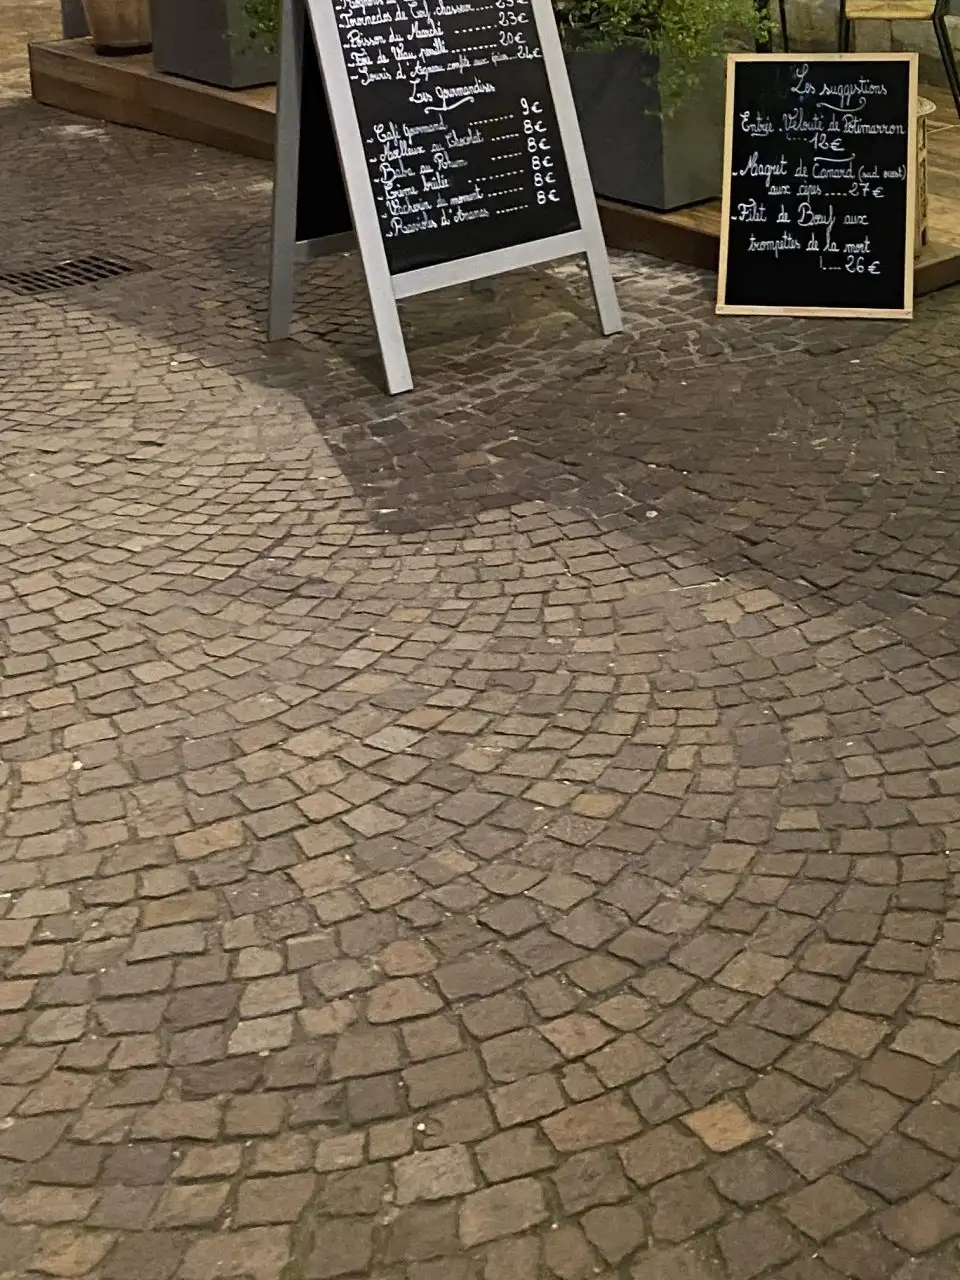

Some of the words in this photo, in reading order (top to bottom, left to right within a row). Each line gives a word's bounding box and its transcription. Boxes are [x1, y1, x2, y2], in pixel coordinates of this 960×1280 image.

[347, 29, 386, 48] Poisson
[389, 27, 404, 42] du
[377, 48, 389, 64] de
[358, 66, 391, 85] Souris
[791, 63, 816, 94] Les
[819, 76, 888, 107] suggestions
[520, 98, 543, 115] 9€
[523, 120, 547, 135] 8€
[783, 107, 825, 131] Velouté
[827, 113, 840, 131] de
[842, 114, 905, 134] Potimarron
[527, 137, 551, 153] 8€
[809, 133, 844, 151] 12€
[531, 156, 554, 170] 8€
[794, 158, 808, 178] de
[812, 160, 855, 178] Canard
[534, 172, 556, 187] 8€
[537, 190, 560, 205] 8€
[737, 199, 767, 222] Filet
[777, 206, 791, 224] de
[843, 214, 869, 225] aux
[748, 233, 801, 258] trompettes
[805, 233, 820, 252] de
[823, 229, 840, 253] la
[843, 236, 871, 253] mort
